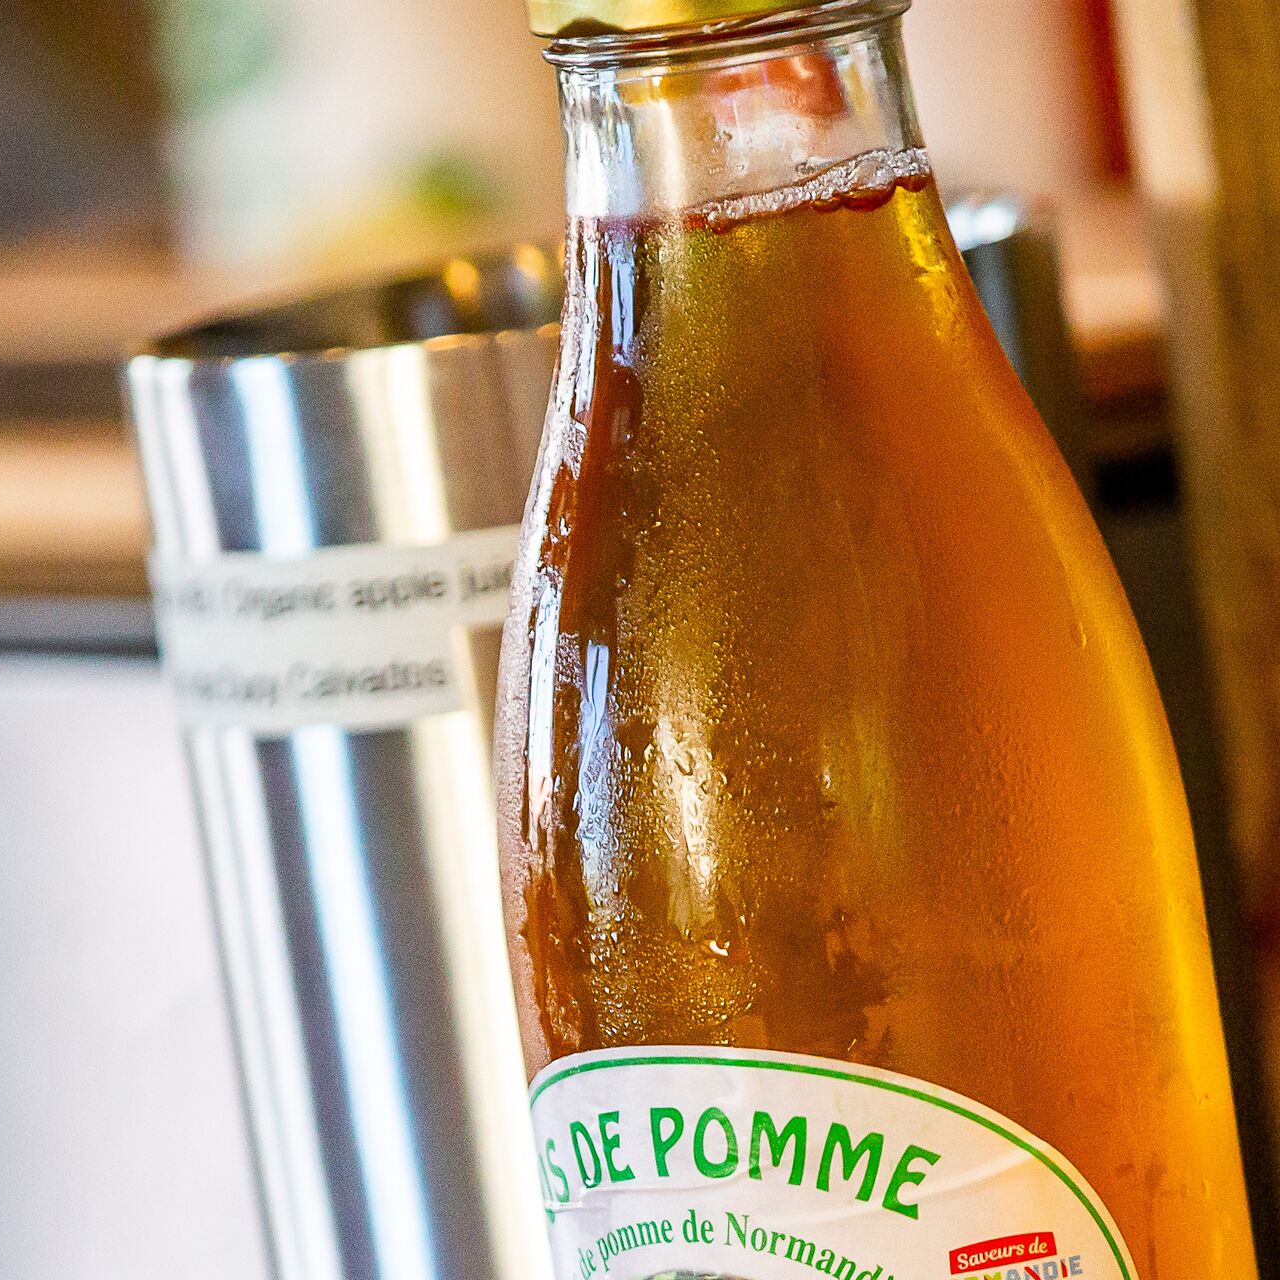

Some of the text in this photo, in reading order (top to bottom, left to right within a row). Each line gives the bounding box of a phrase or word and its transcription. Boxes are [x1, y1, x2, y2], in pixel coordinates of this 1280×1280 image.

[570, 1110, 635, 1189] DE
[649, 1106, 942, 1220] POMME
[578, 1247, 597, 1280] de
[595, 1218, 674, 1273] pomme
[681, 1208, 715, 1244] de
[956, 1235, 1049, 1270] Saveurs de
